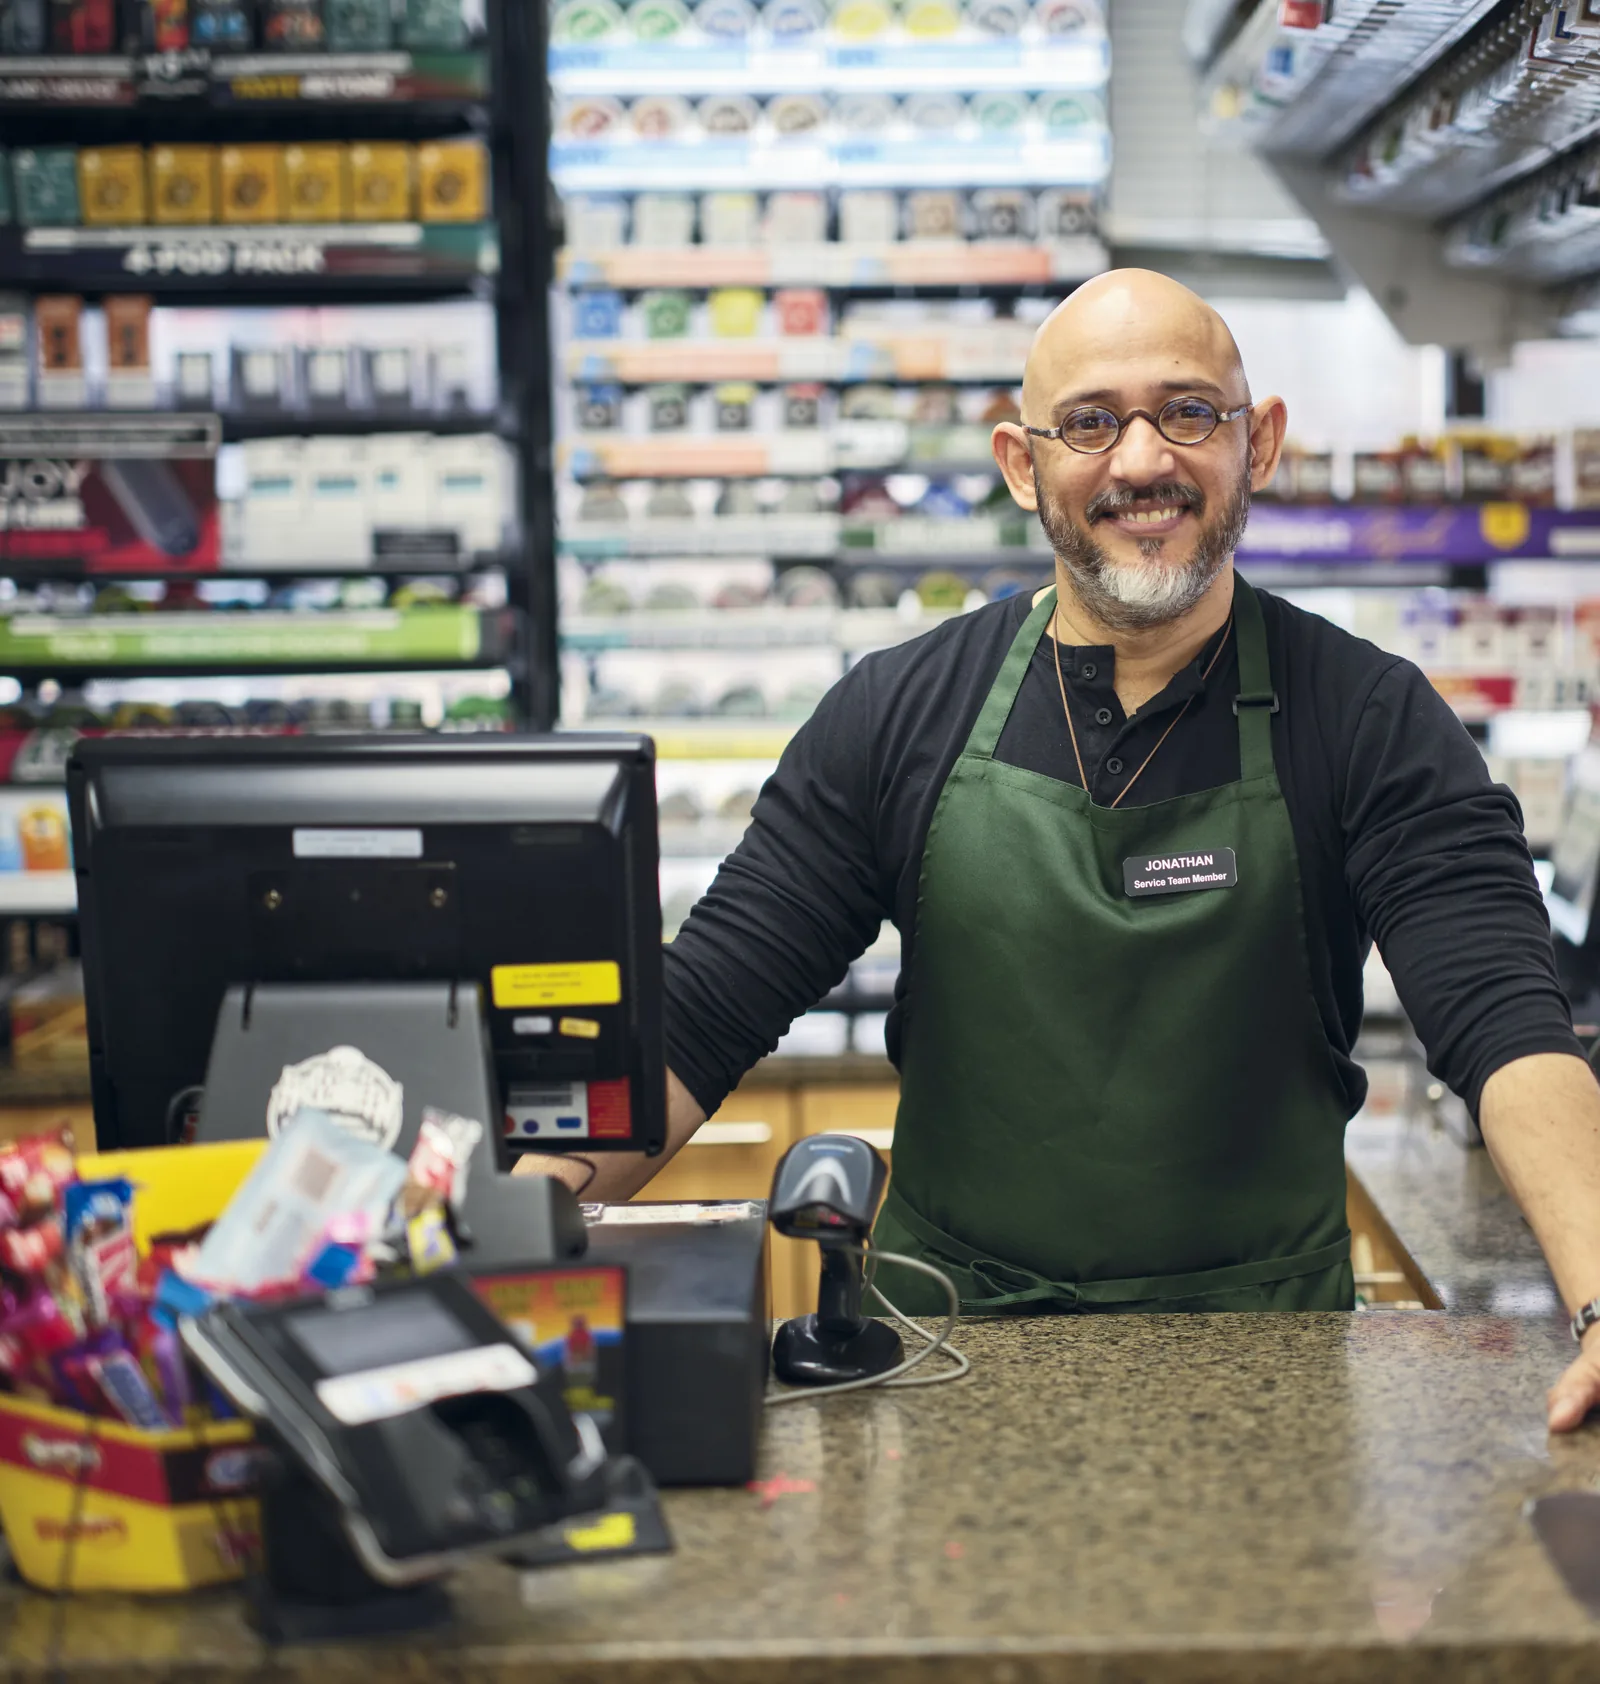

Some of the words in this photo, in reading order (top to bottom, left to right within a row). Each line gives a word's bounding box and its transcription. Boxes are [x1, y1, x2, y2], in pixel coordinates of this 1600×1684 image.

[1145, 854, 1214, 872] JONATHAN
[1133, 878, 1166, 889] Service
[1167, 876, 1191, 886] Team
[1192, 872, 1228, 883] Member
